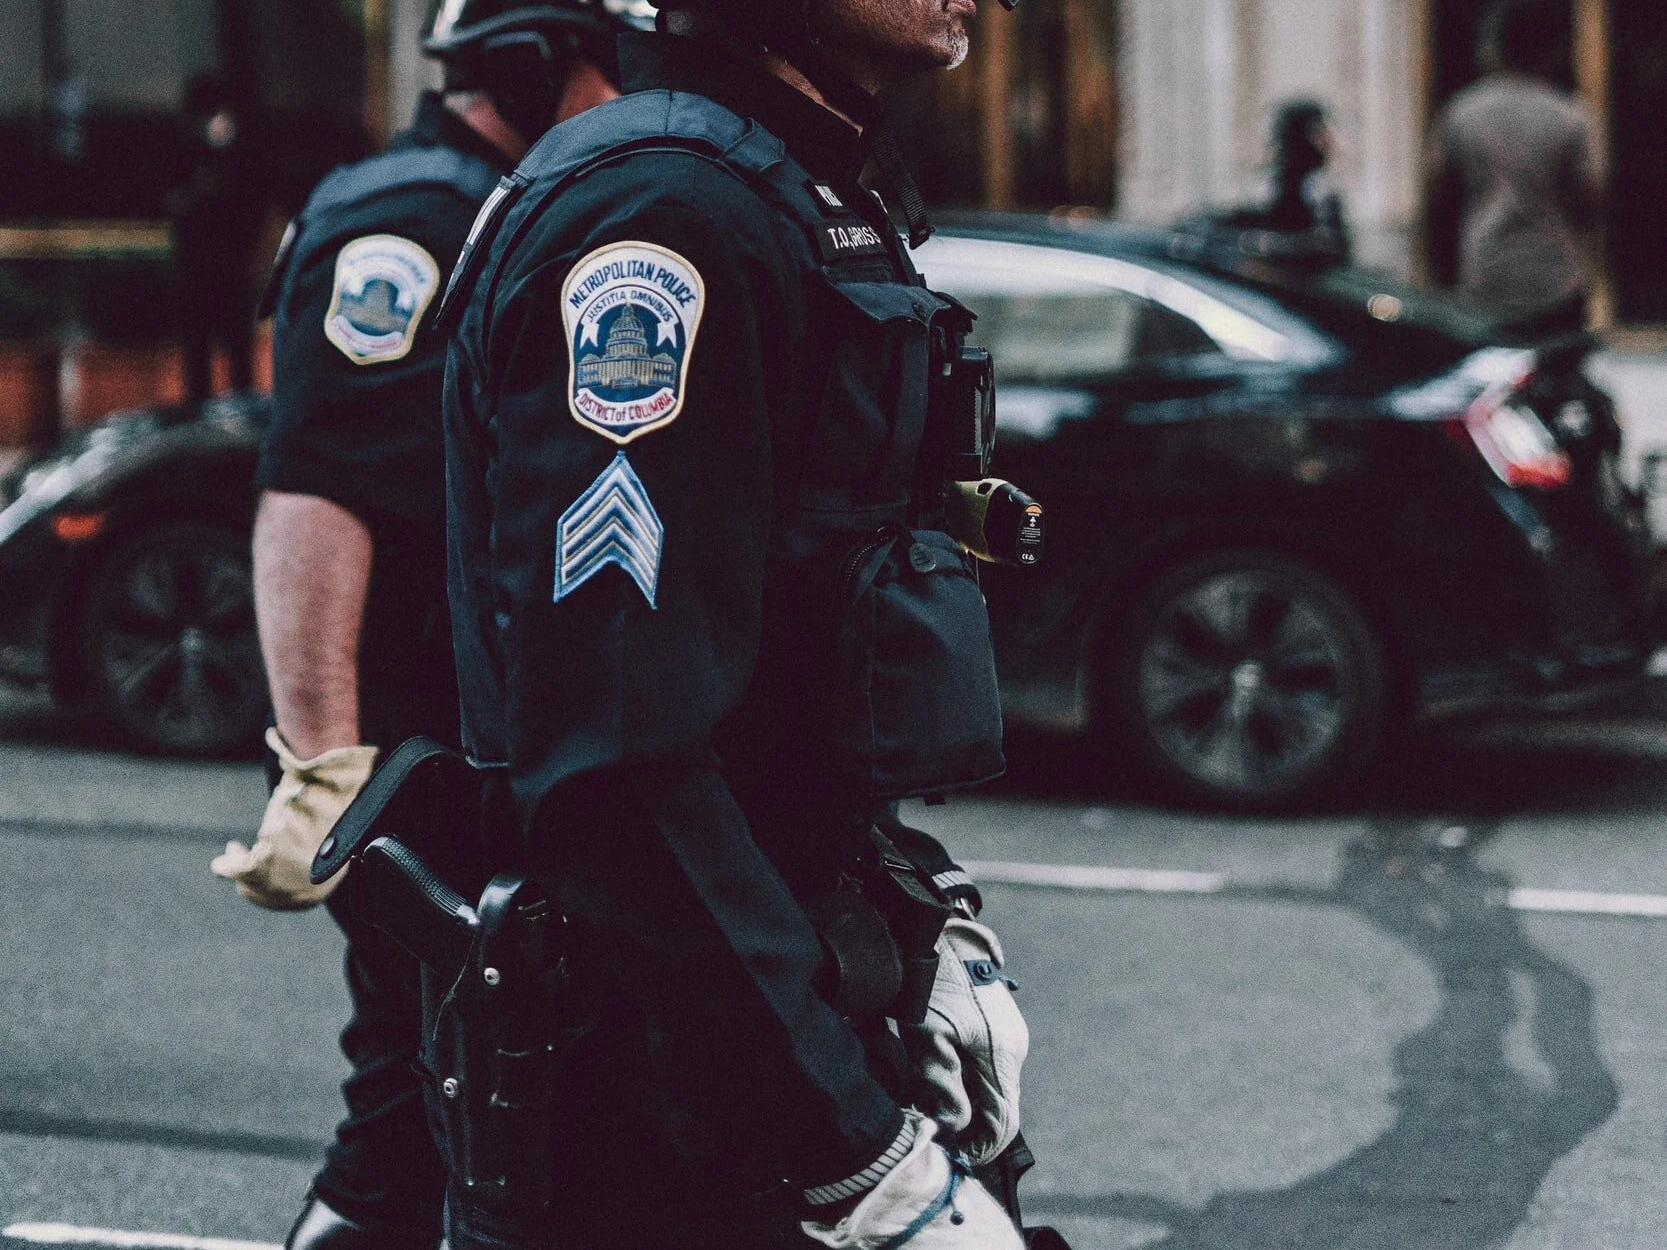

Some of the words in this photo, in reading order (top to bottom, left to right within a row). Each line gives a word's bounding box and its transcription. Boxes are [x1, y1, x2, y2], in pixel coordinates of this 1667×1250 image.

[569, 260, 655, 309] METROPOLITAN
[654, 268, 696, 308] POLICE
[586, 291, 626, 323] JUSTITIA
[631, 290, 674, 322] OMNIBUS
[579, 393, 617, 421] DISTRICT
[628, 392, 672, 420] COLUMBIA
